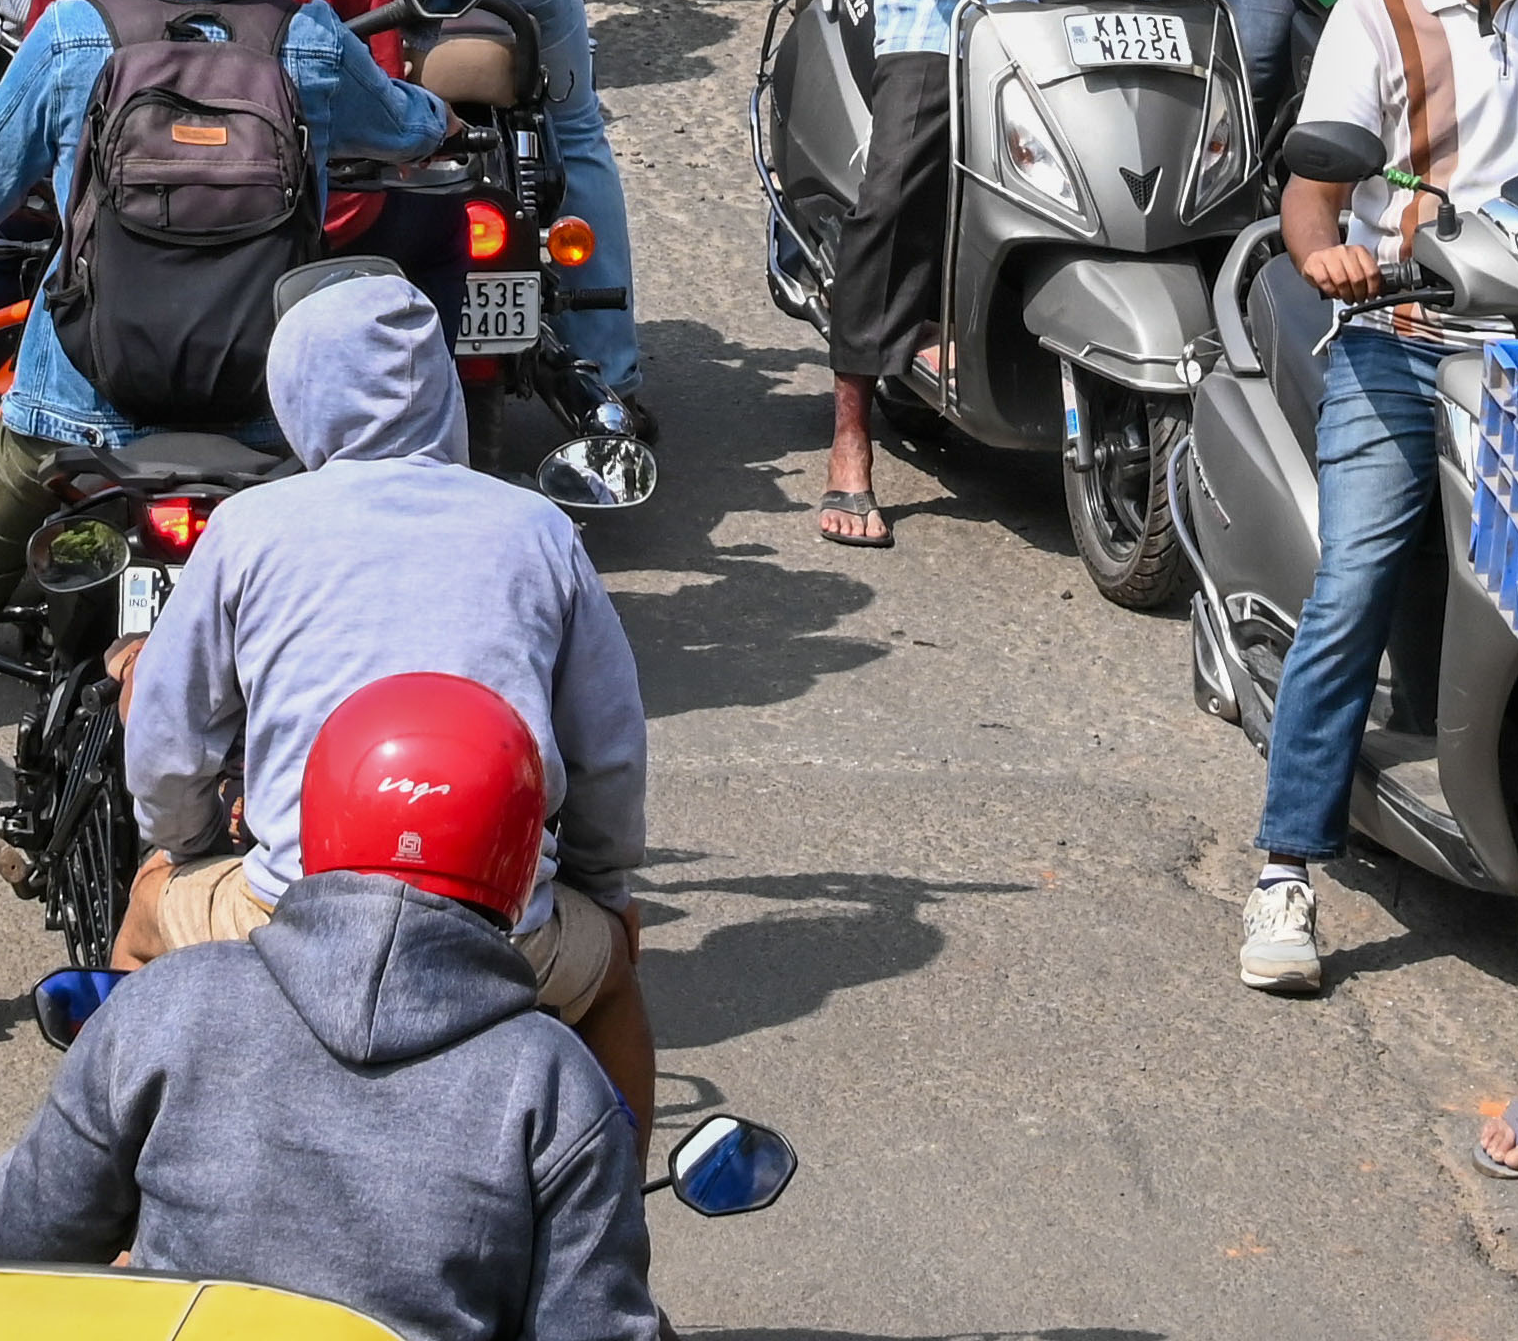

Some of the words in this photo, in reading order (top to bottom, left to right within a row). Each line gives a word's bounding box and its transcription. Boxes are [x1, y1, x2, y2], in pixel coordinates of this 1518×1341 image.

[1095, 16, 1175, 39] KA13E
[1102, 40, 1183, 61] N2254
[129, 594, 149, 608] IND
